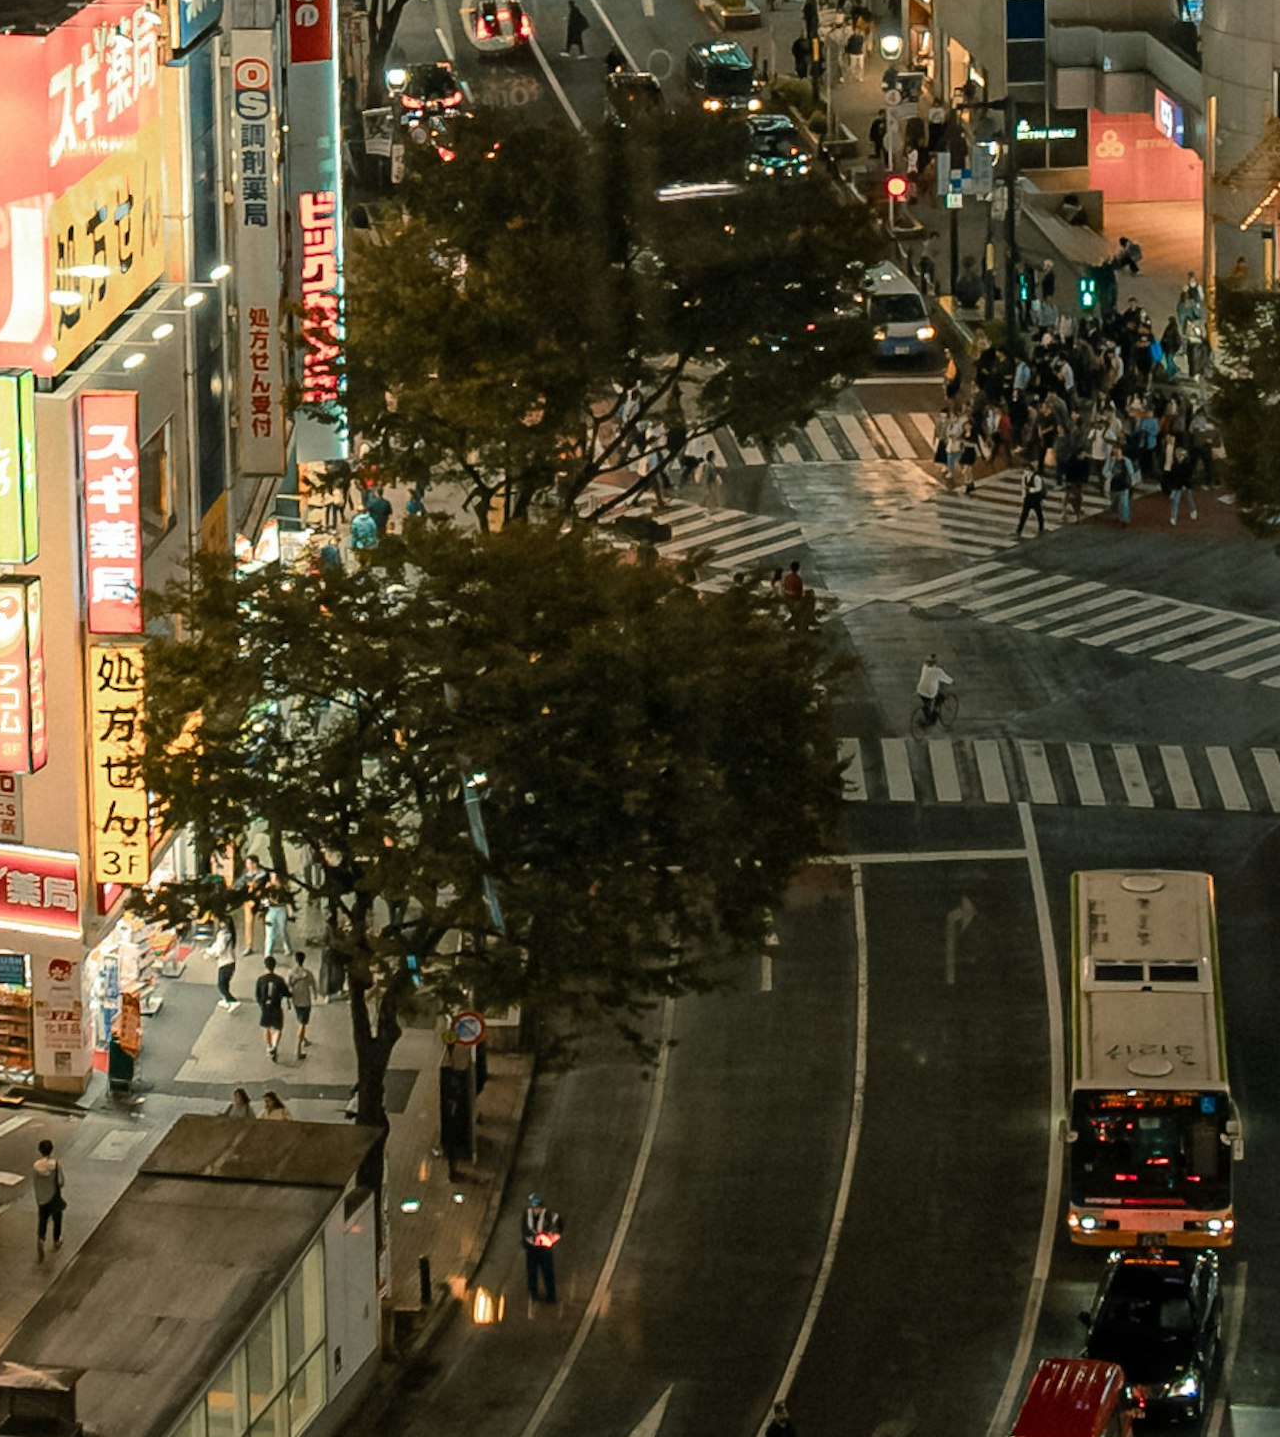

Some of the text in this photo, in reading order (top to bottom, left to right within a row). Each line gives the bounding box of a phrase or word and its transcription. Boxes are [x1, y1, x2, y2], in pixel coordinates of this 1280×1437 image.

[49, 13, 159, 166] スギ薬局
[235, 57, 271, 121] OS
[240, 125, 269, 228] 調剤薬局
[248, 307, 273, 438] 処方せん受付
[87, 423, 136, 603] スギ薬局
[0, 662, 22, 735] アコム
[97, 654, 140, 847] 処方せん
[101, 850, 140, 877] 3F
